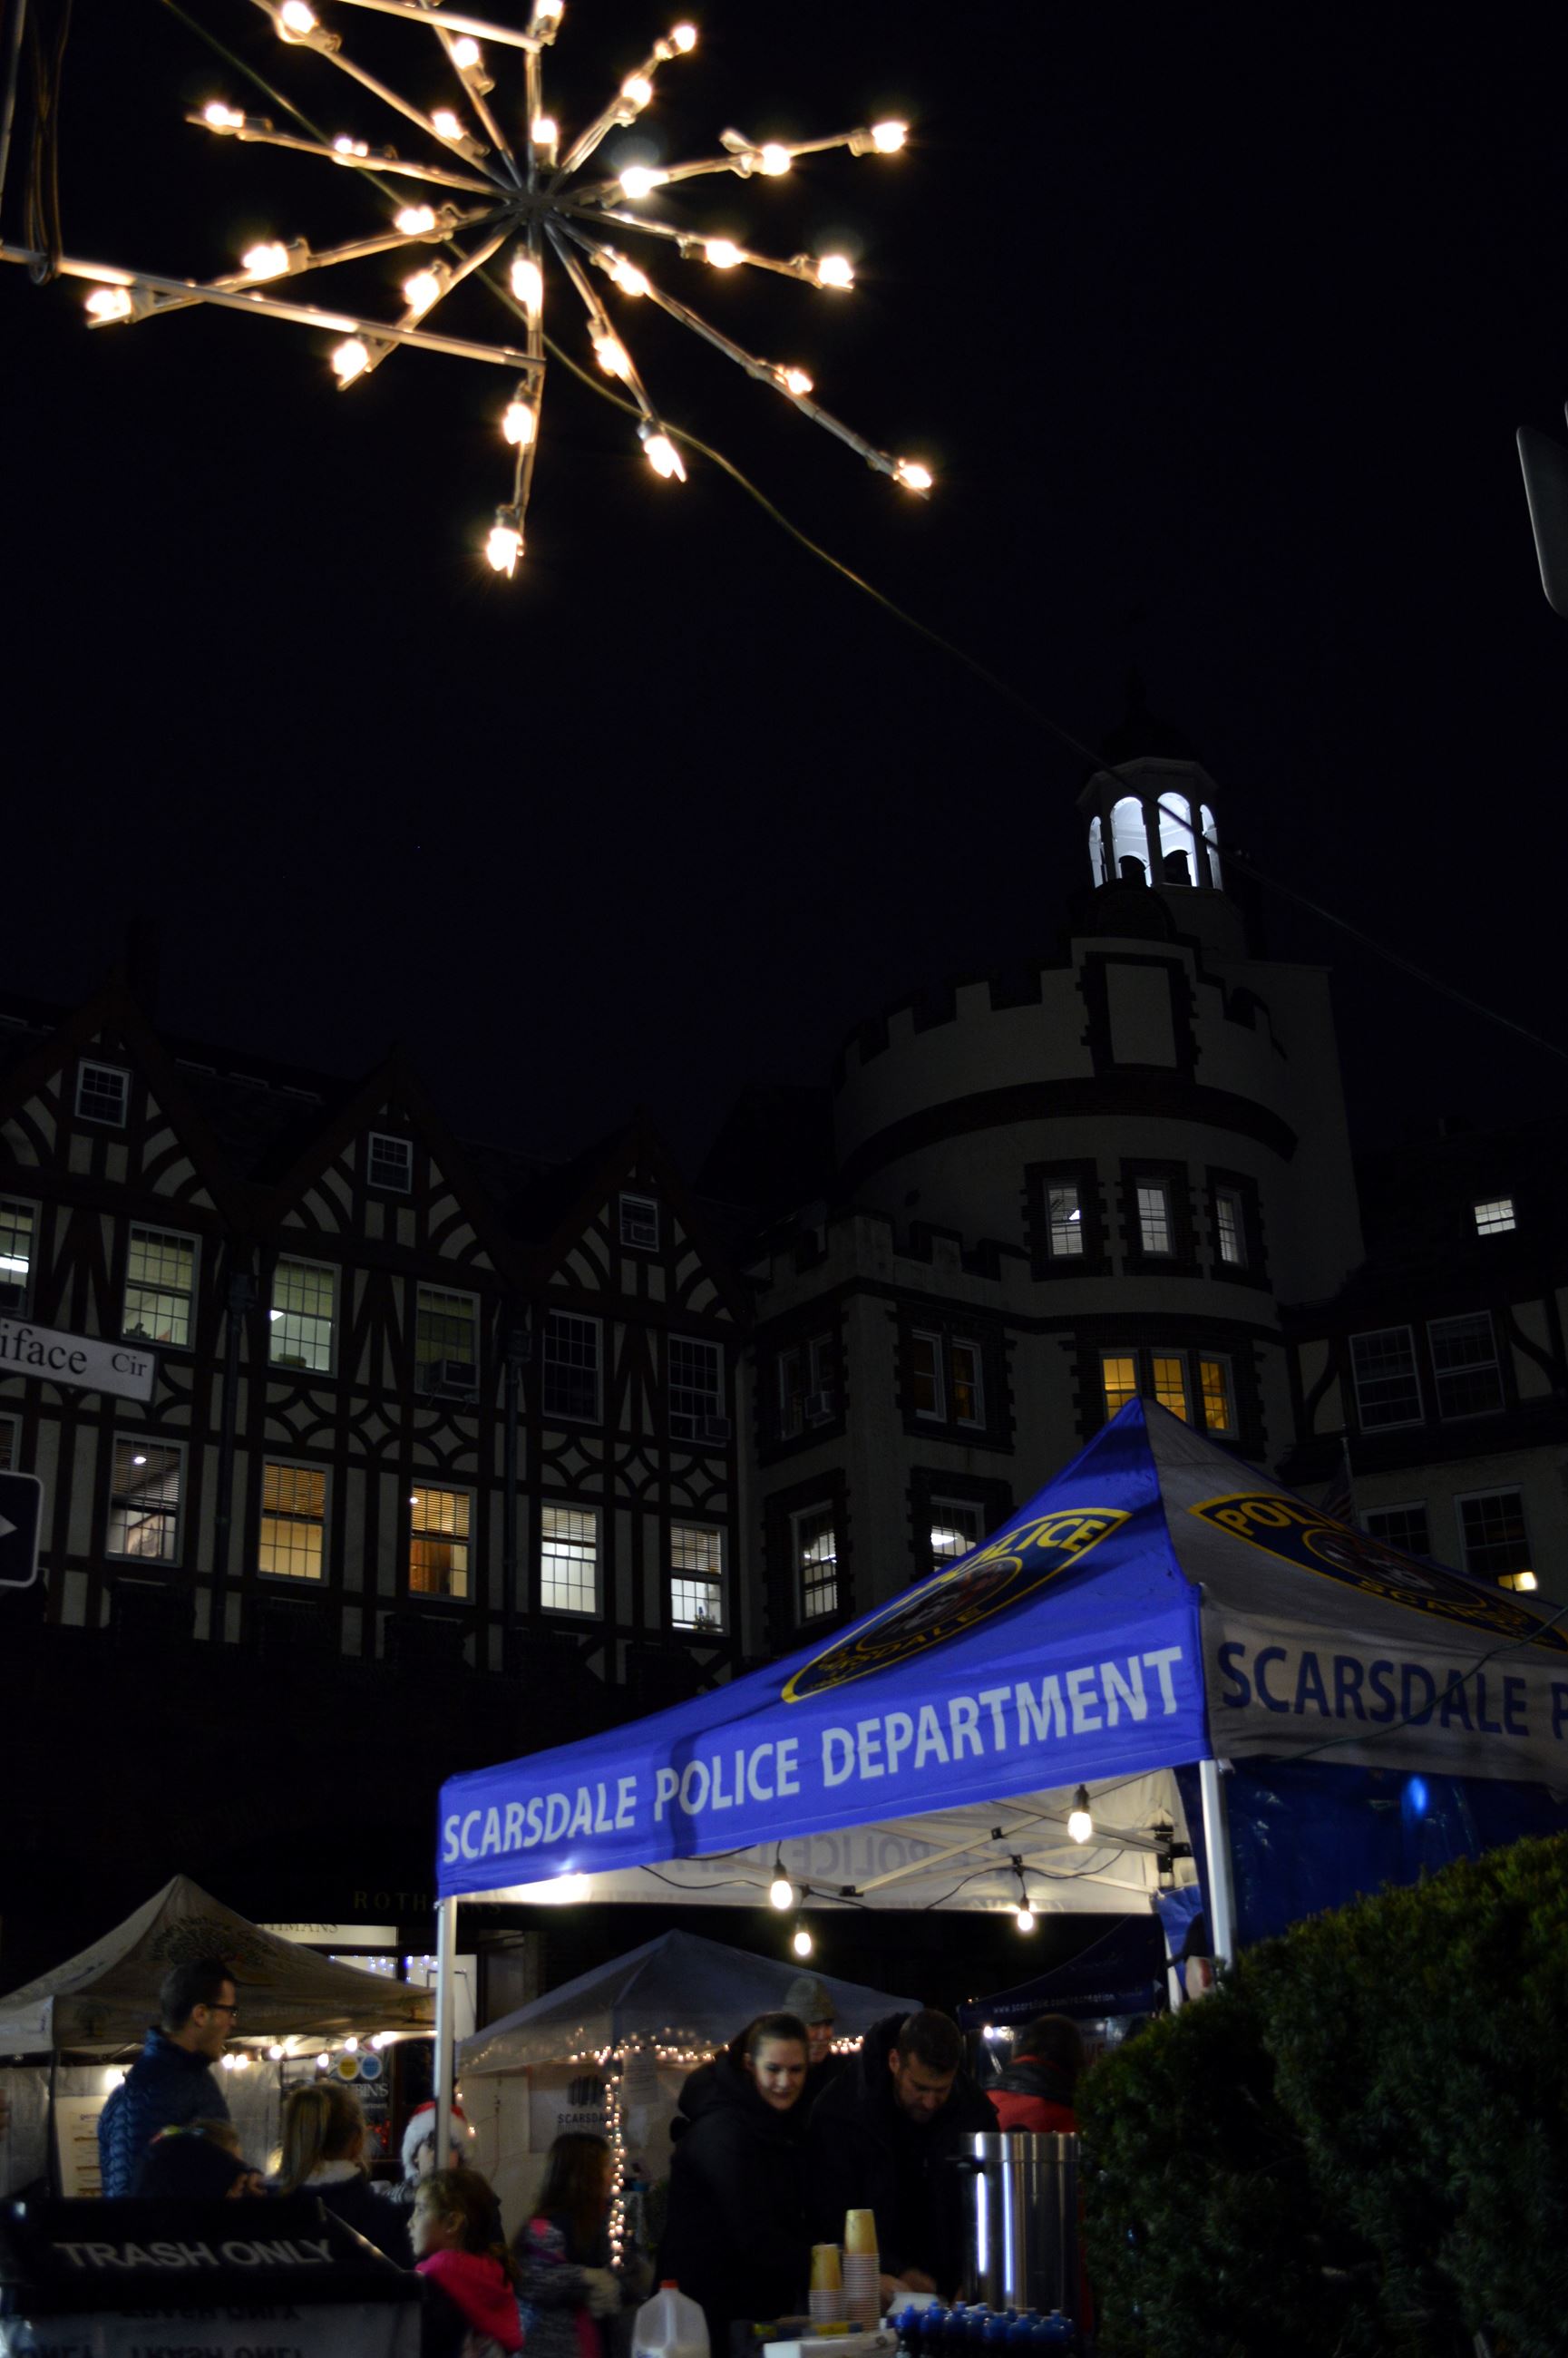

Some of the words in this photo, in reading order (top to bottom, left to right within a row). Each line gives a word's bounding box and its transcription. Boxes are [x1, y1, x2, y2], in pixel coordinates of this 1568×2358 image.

[112, 1352, 148, 1377] Cir
[1217, 1641, 1530, 1738] SCARSDALE
[443, 1775, 638, 1864] SCARSDALE
[653, 1737, 801, 1823] POLICE
[821, 1645, 1183, 1788] DEPARTMENT
[50, 2240, 220, 2268] TRASH
[220, 2237, 336, 2266] ONLY
